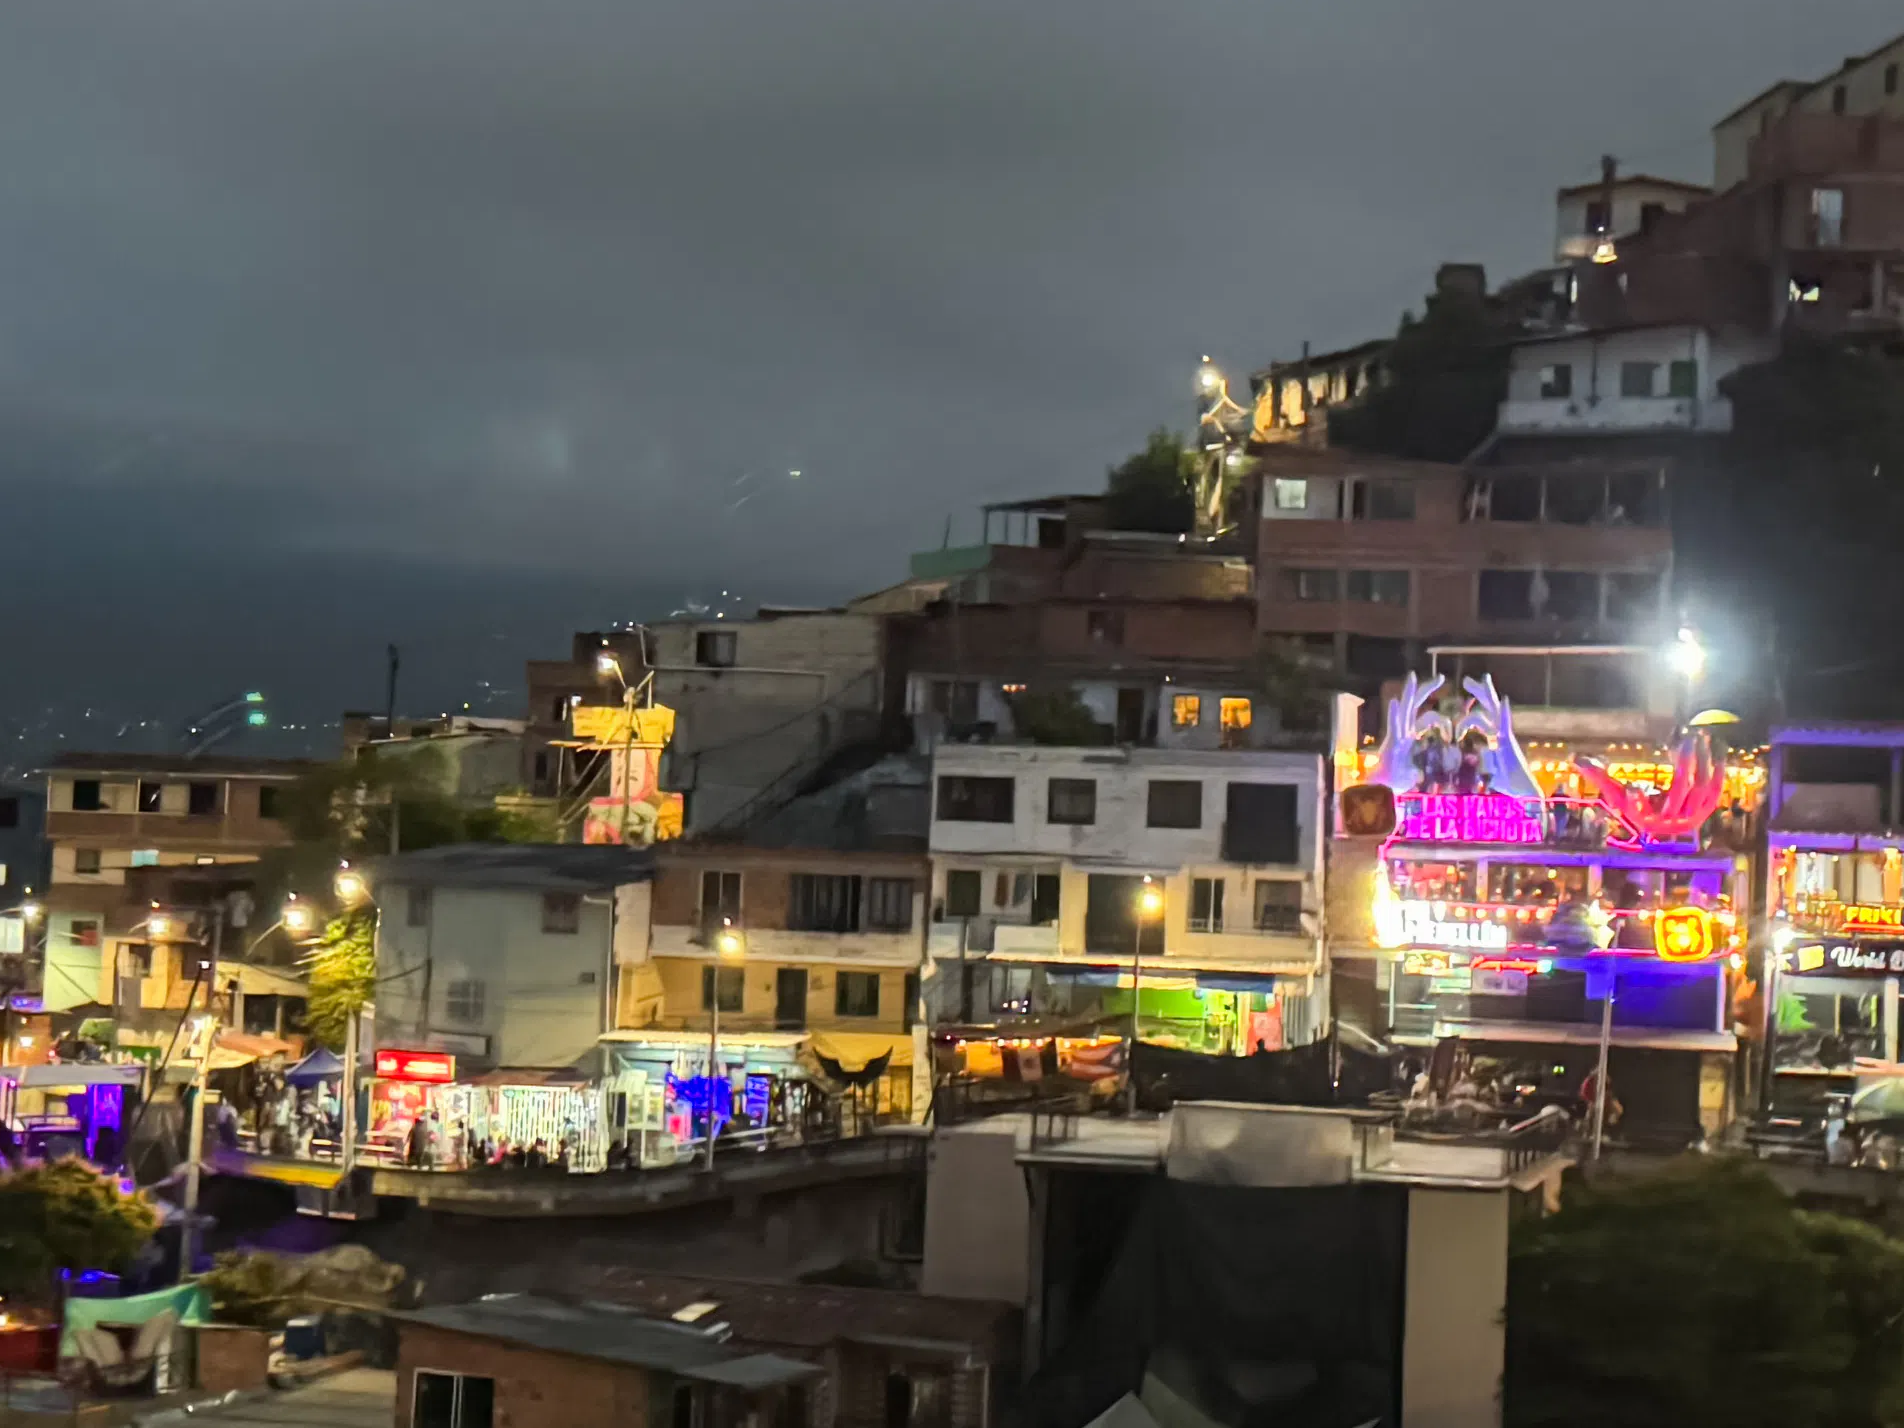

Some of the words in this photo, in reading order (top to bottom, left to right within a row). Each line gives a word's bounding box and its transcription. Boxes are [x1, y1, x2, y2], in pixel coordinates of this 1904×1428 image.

[1422, 795, 1457, 818] LAS
[1434, 817, 1458, 839] LA
[1830, 946, 1887, 970] World
